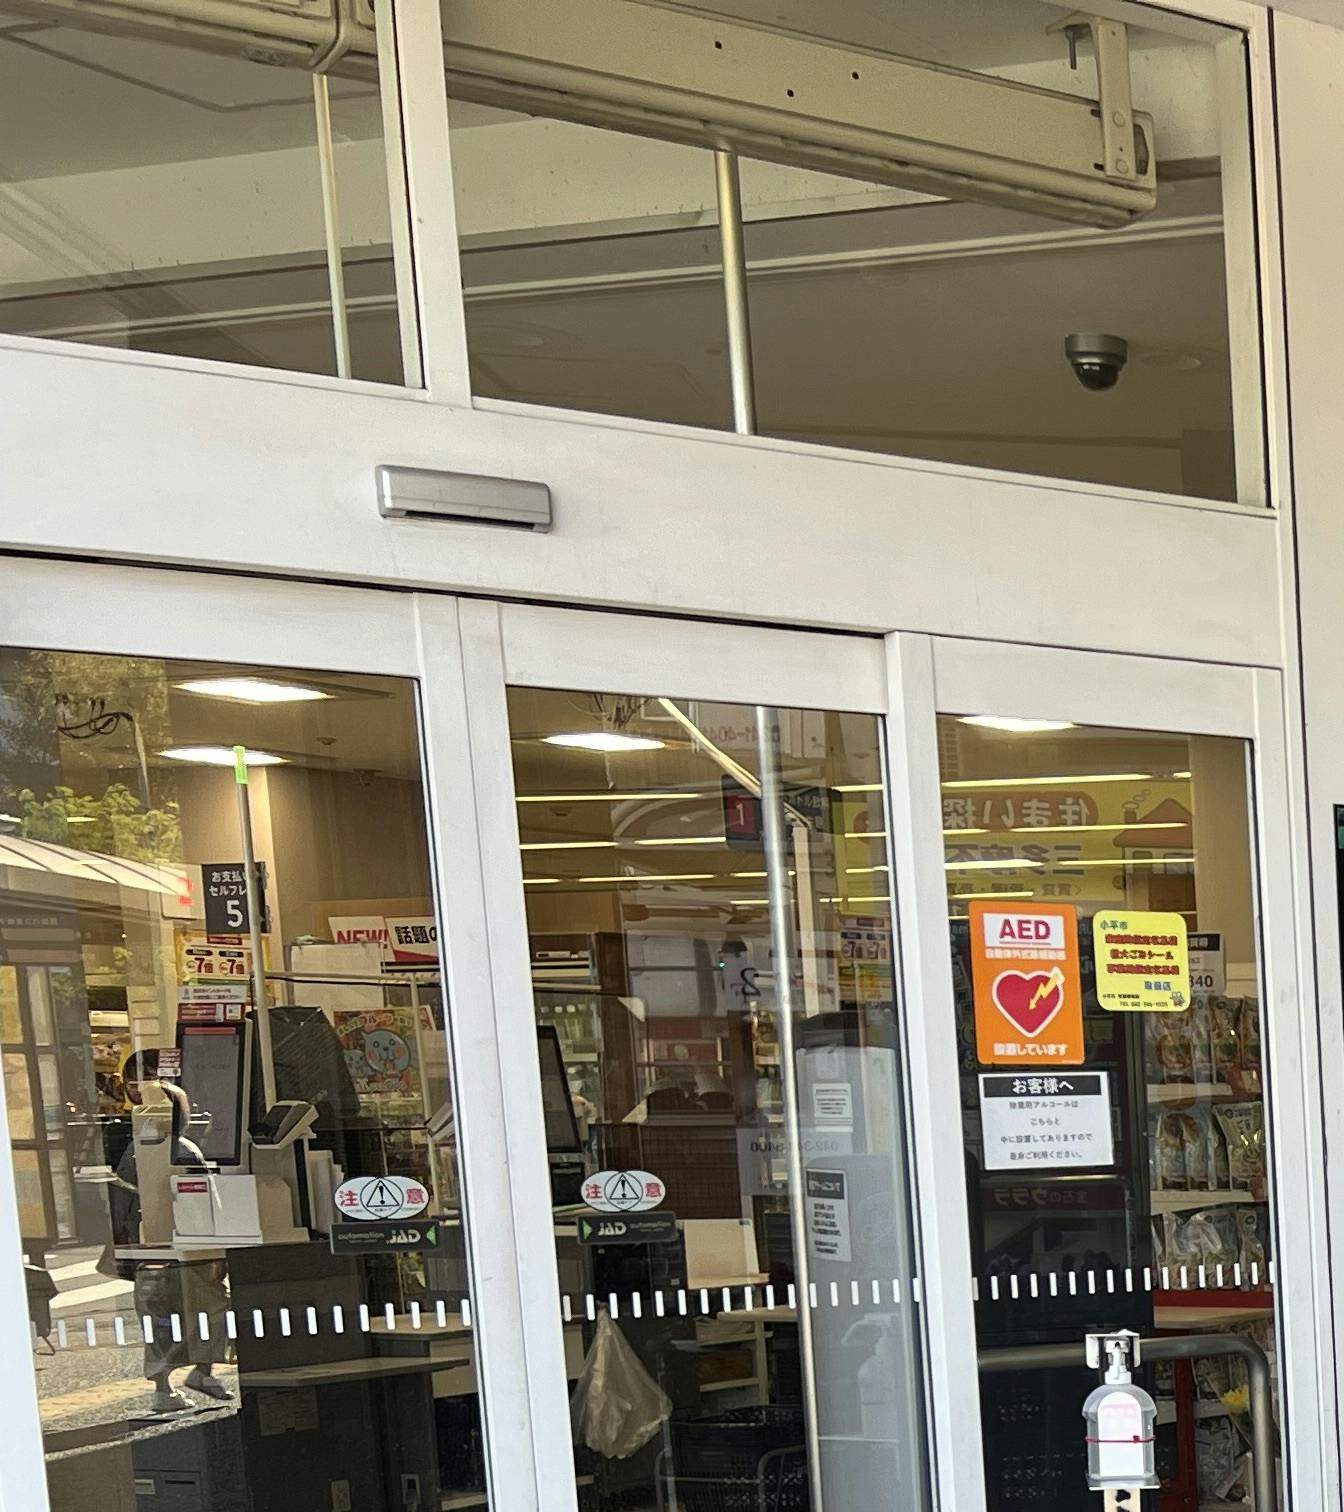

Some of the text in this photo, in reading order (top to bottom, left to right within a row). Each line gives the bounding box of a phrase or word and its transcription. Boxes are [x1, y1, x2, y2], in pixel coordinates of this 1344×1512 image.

[209, 885, 247, 897] セルフレ
[226, 899, 244, 928] 5
[1000, 918, 1051, 940] AED
[1012, 1078, 1075, 1094] お客様へ
[339, 1190, 359, 1207] 注
